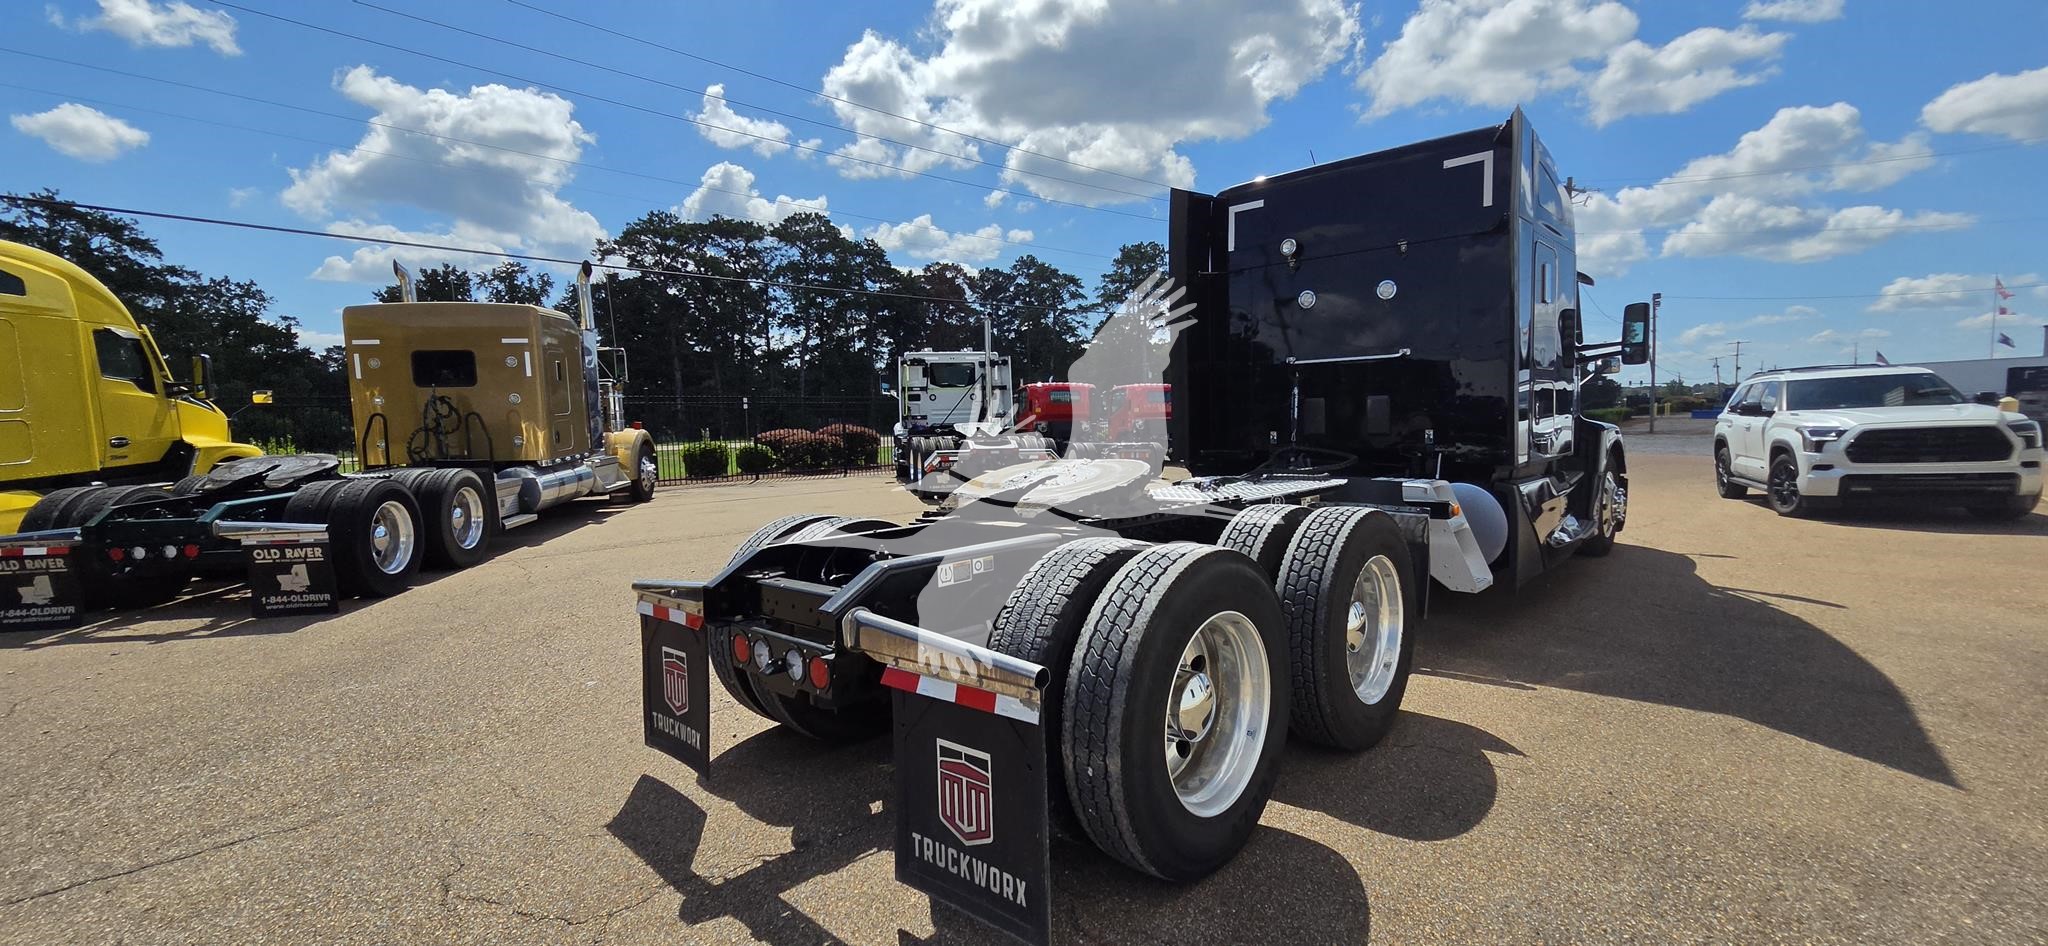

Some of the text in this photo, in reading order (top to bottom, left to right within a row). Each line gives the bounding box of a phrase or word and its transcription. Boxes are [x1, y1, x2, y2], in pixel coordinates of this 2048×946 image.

[253, 549, 280, 559] OLD
[261, 593, 331, 604] 1-844-OLDRIVR
[652, 711, 701, 750] TRUCKWORX
[911, 832, 1027, 908] TRUCKWORX
